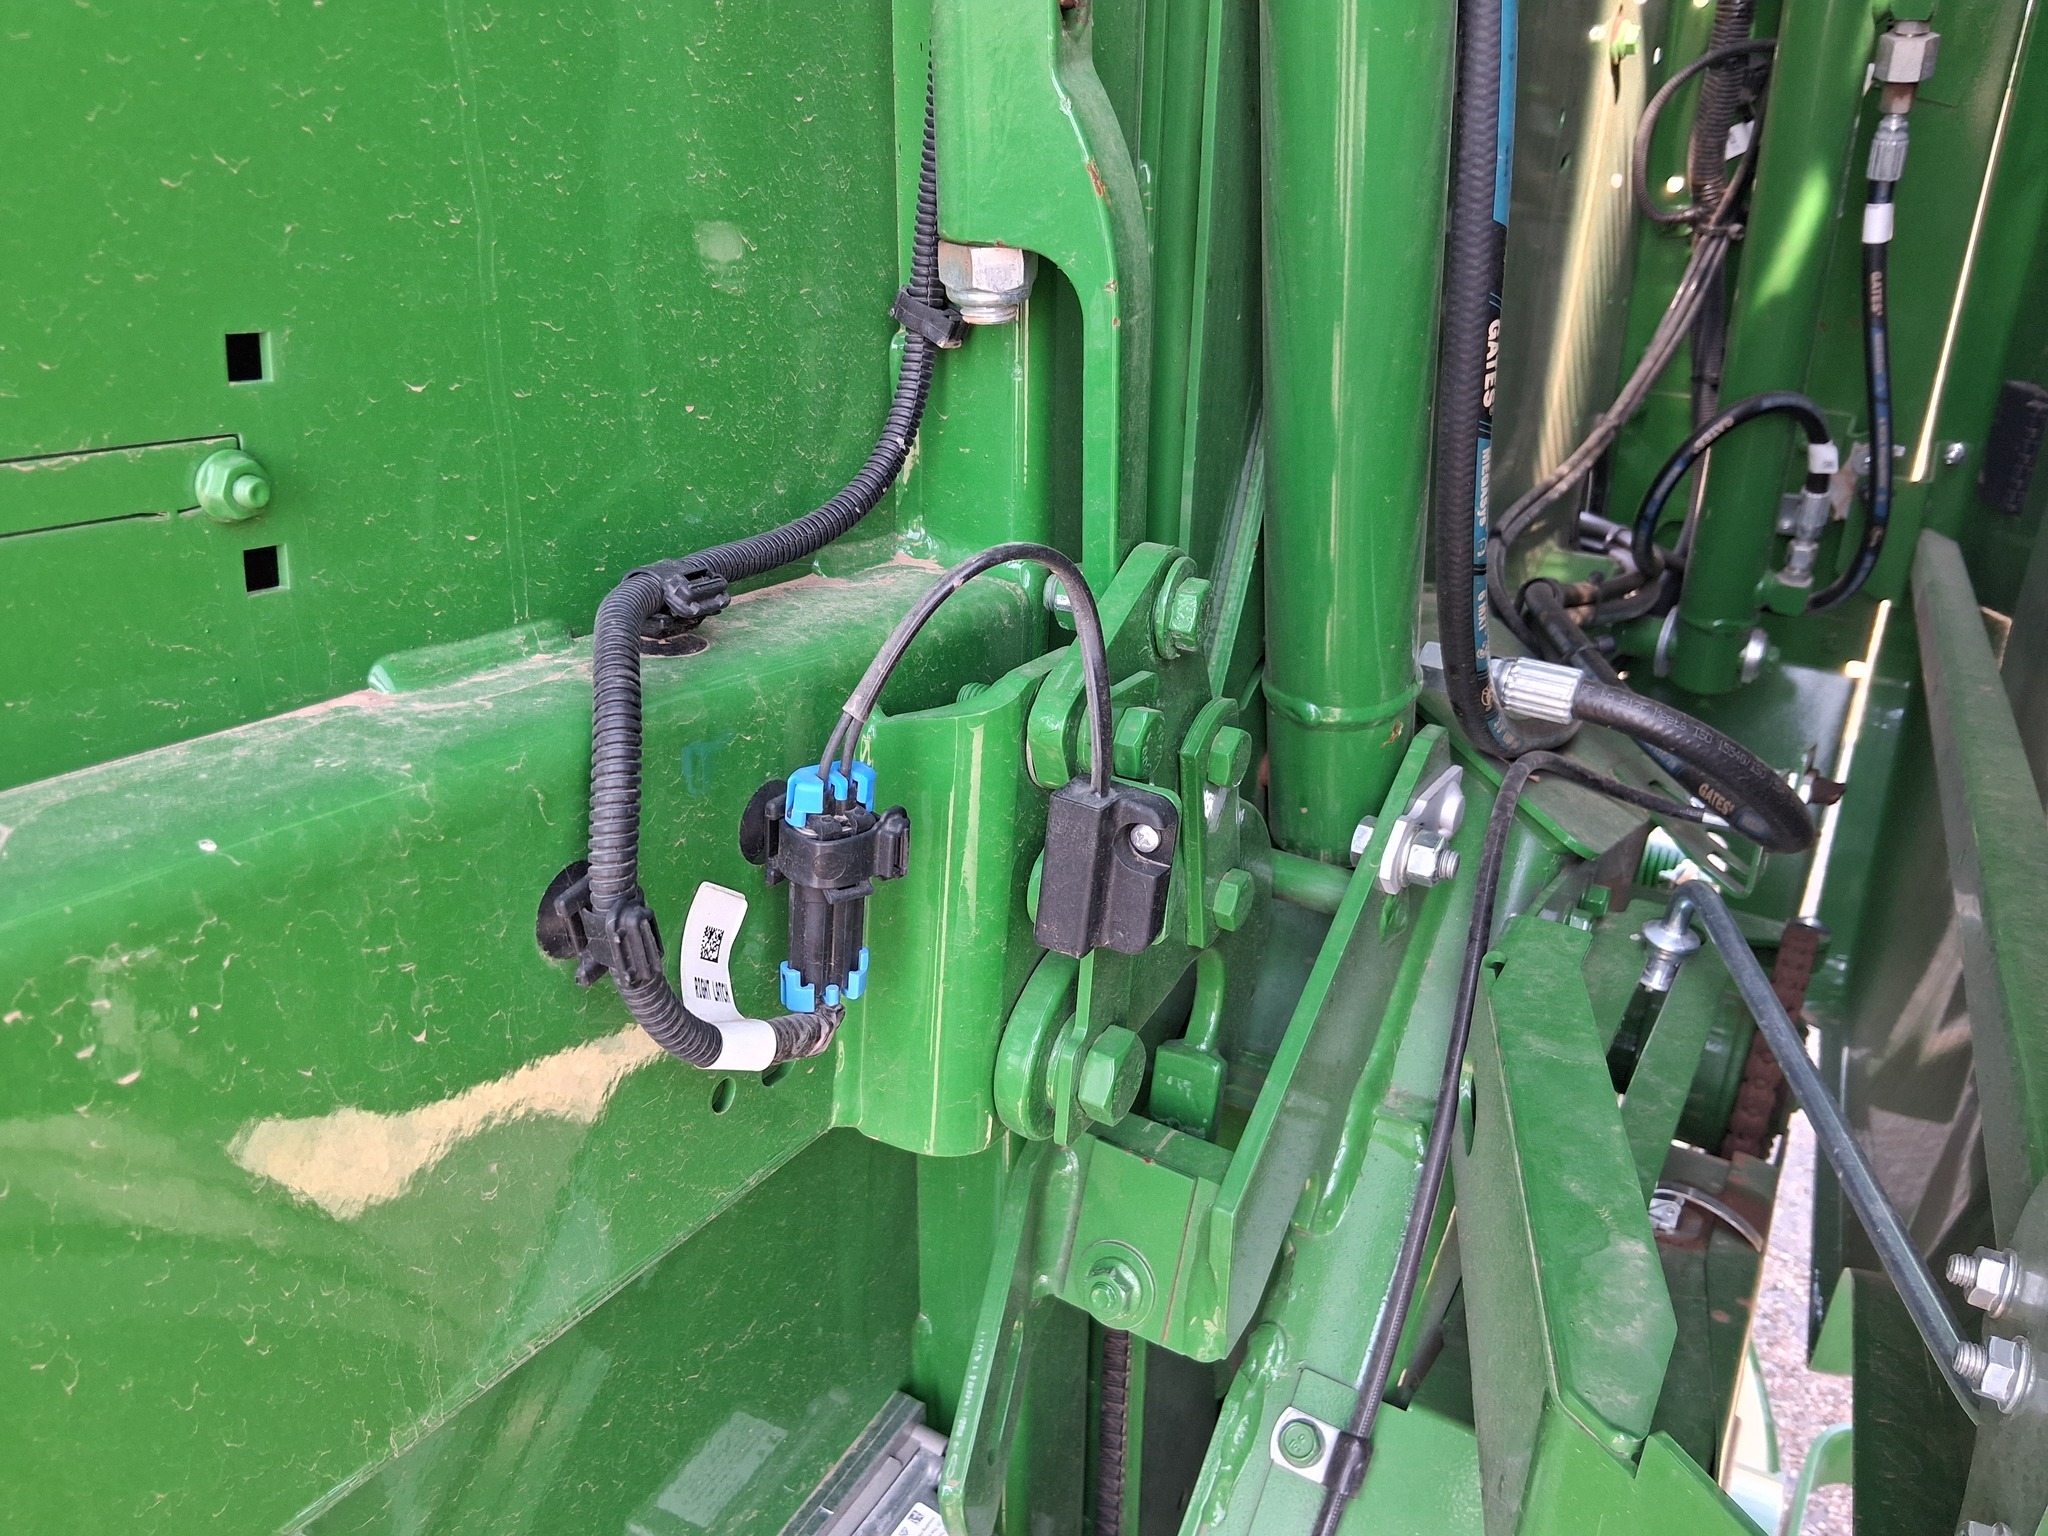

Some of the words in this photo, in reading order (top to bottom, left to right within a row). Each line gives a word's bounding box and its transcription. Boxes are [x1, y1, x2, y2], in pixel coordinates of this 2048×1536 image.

[1483, 319, 1500, 408] GATES
[1698, 783, 1733, 815] GATES
[694, 976, 711, 1000] RIGHT
[712, 981, 731, 1003] LATCH
